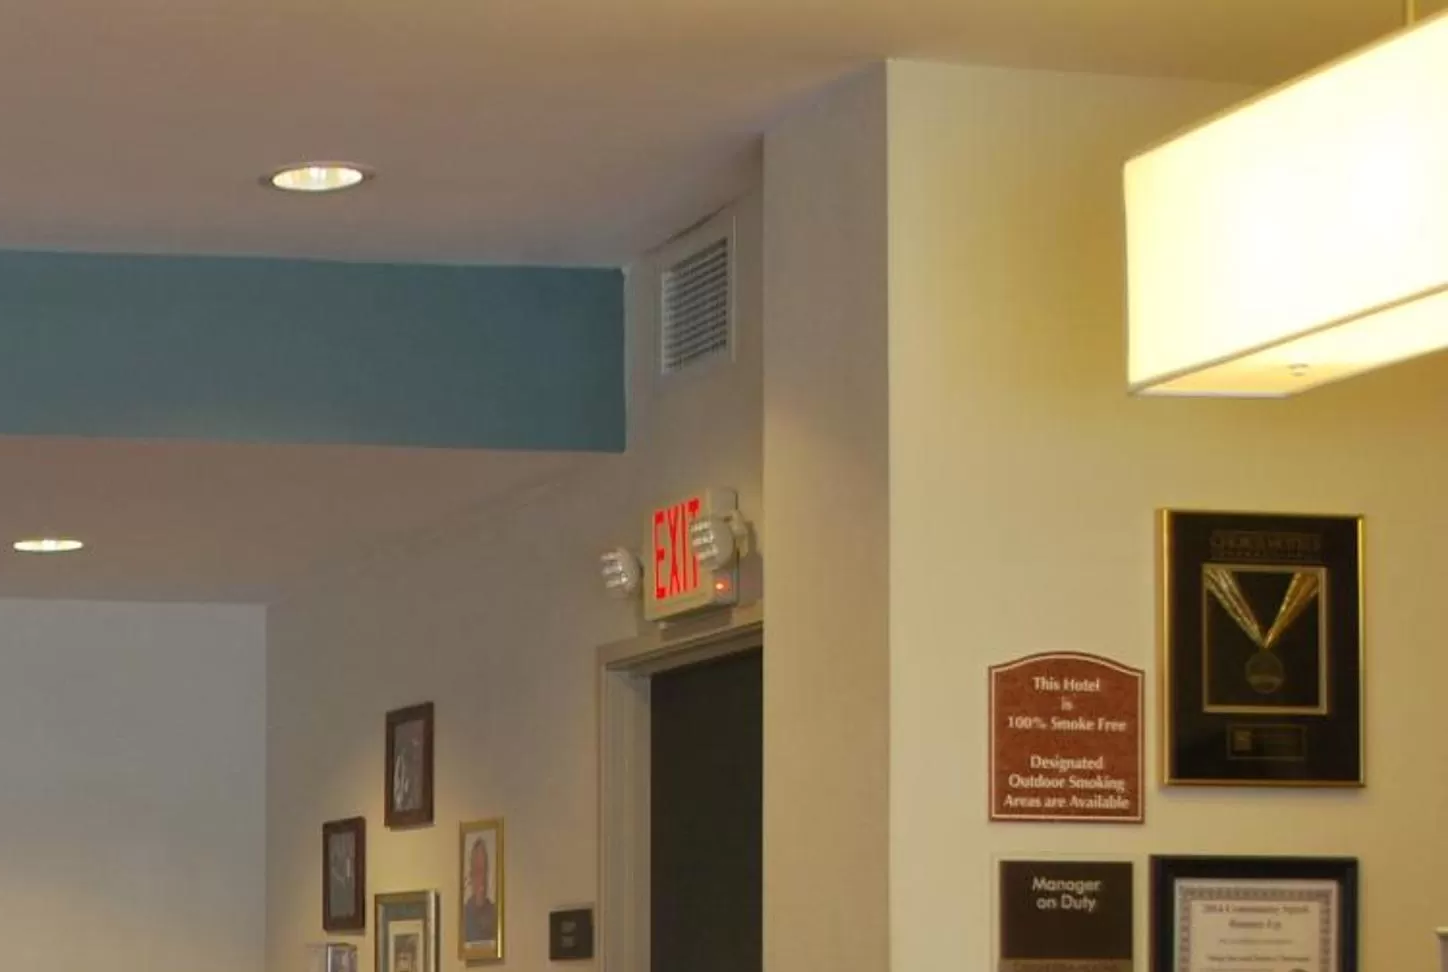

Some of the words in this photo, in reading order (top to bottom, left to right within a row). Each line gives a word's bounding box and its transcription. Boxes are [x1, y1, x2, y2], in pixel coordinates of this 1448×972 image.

[653, 497, 700, 600] EXIT
[1032, 676, 1061, 691] This
[1063, 677, 1101, 692] Hotel
[1060, 696, 1074, 711] is
[1008, 716, 1047, 729] 100%
[1050, 716, 1095, 731] Smoke
[1097, 717, 1127, 732] Free
[1030, 755, 1104, 772] Designated
[1008, 773, 1065, 788] Outdoor
[1068, 774, 1126, 793] Smoking
[1004, 794, 1042, 808] Areas
[1044, 797, 1067, 808] are
[1069, 795, 1130, 809] Available
[1032, 876, 1103, 895] Manager
[1036, 897, 1057, 909] on
[1060, 893, 1097, 913] Duty
